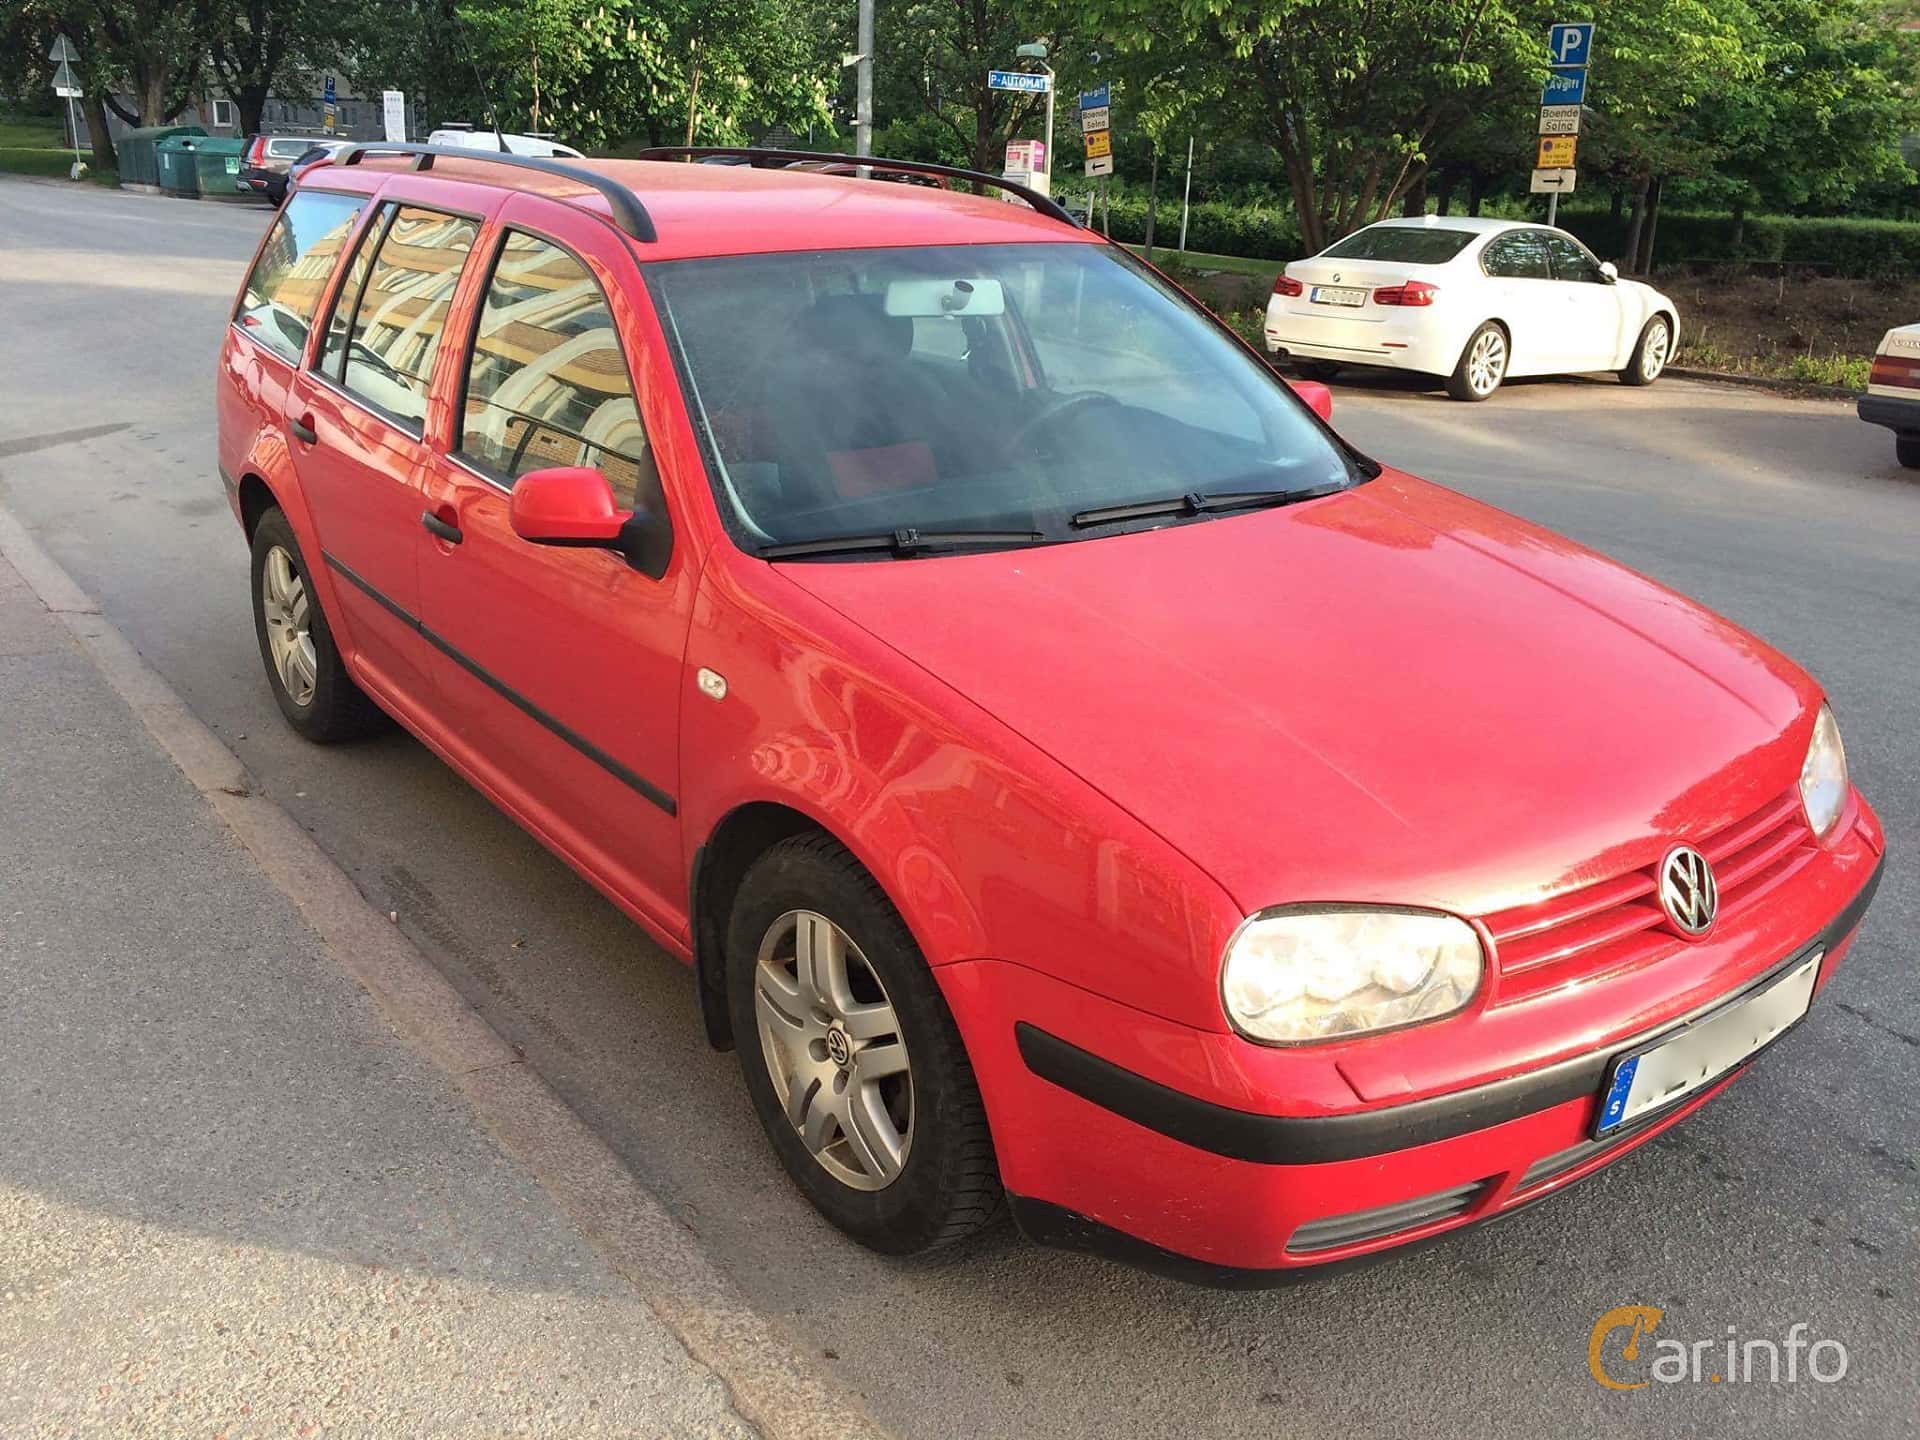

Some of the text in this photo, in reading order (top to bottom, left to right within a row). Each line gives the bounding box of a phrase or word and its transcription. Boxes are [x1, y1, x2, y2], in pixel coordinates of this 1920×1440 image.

[1560, 28, 1582, 62] P
[327, 77, 333, 89] P
[1542, 108, 1578, 118] Boende
[1545, 121, 1573, 131] Solna
[1609, 1100, 1620, 1115] S
